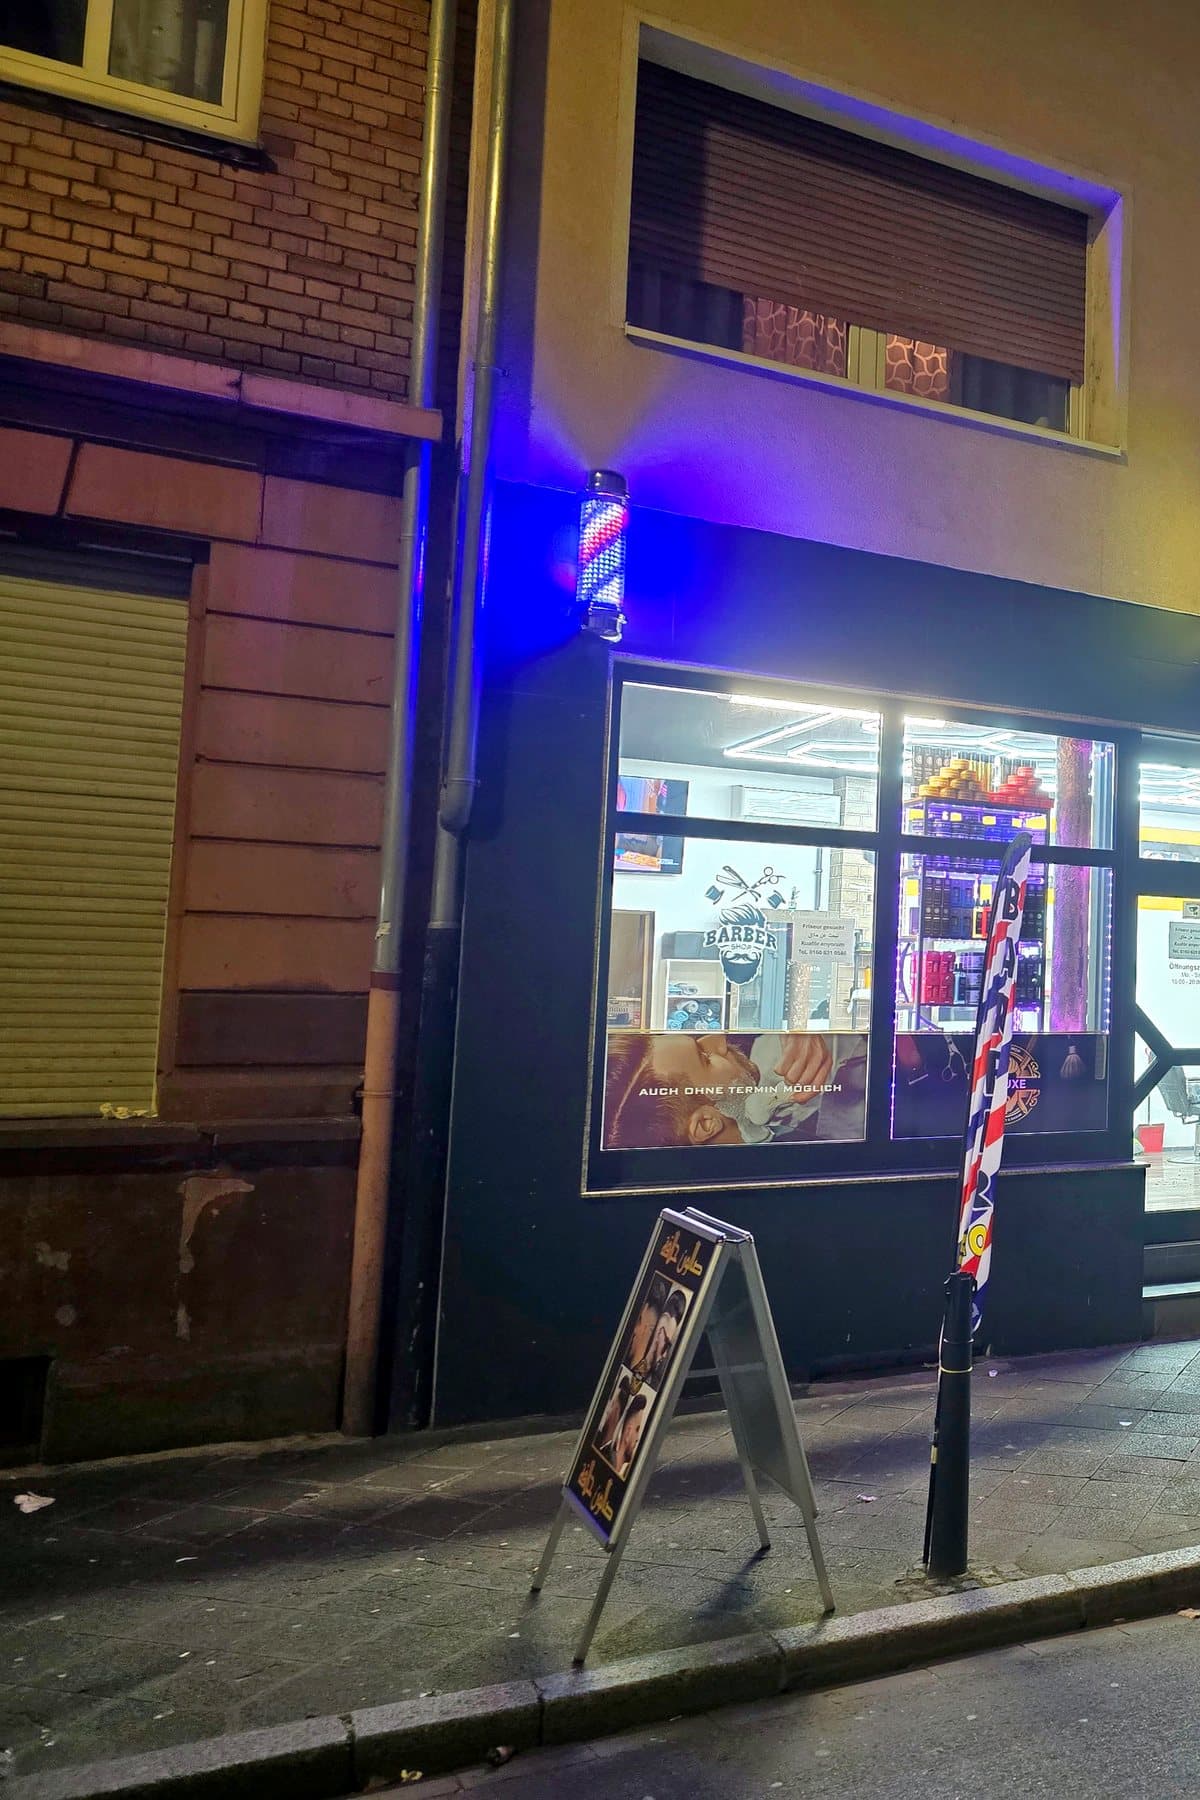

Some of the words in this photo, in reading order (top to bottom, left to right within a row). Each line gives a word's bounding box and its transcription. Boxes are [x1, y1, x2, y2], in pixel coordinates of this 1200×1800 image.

[705, 925, 777, 949] BARBER
[639, 1087, 679, 1096] AUCH
[684, 1086, 723, 1095] OHNE
[728, 1085, 778, 1094] TERMIN
[784, 1083, 842, 1093] MÖGLICH
